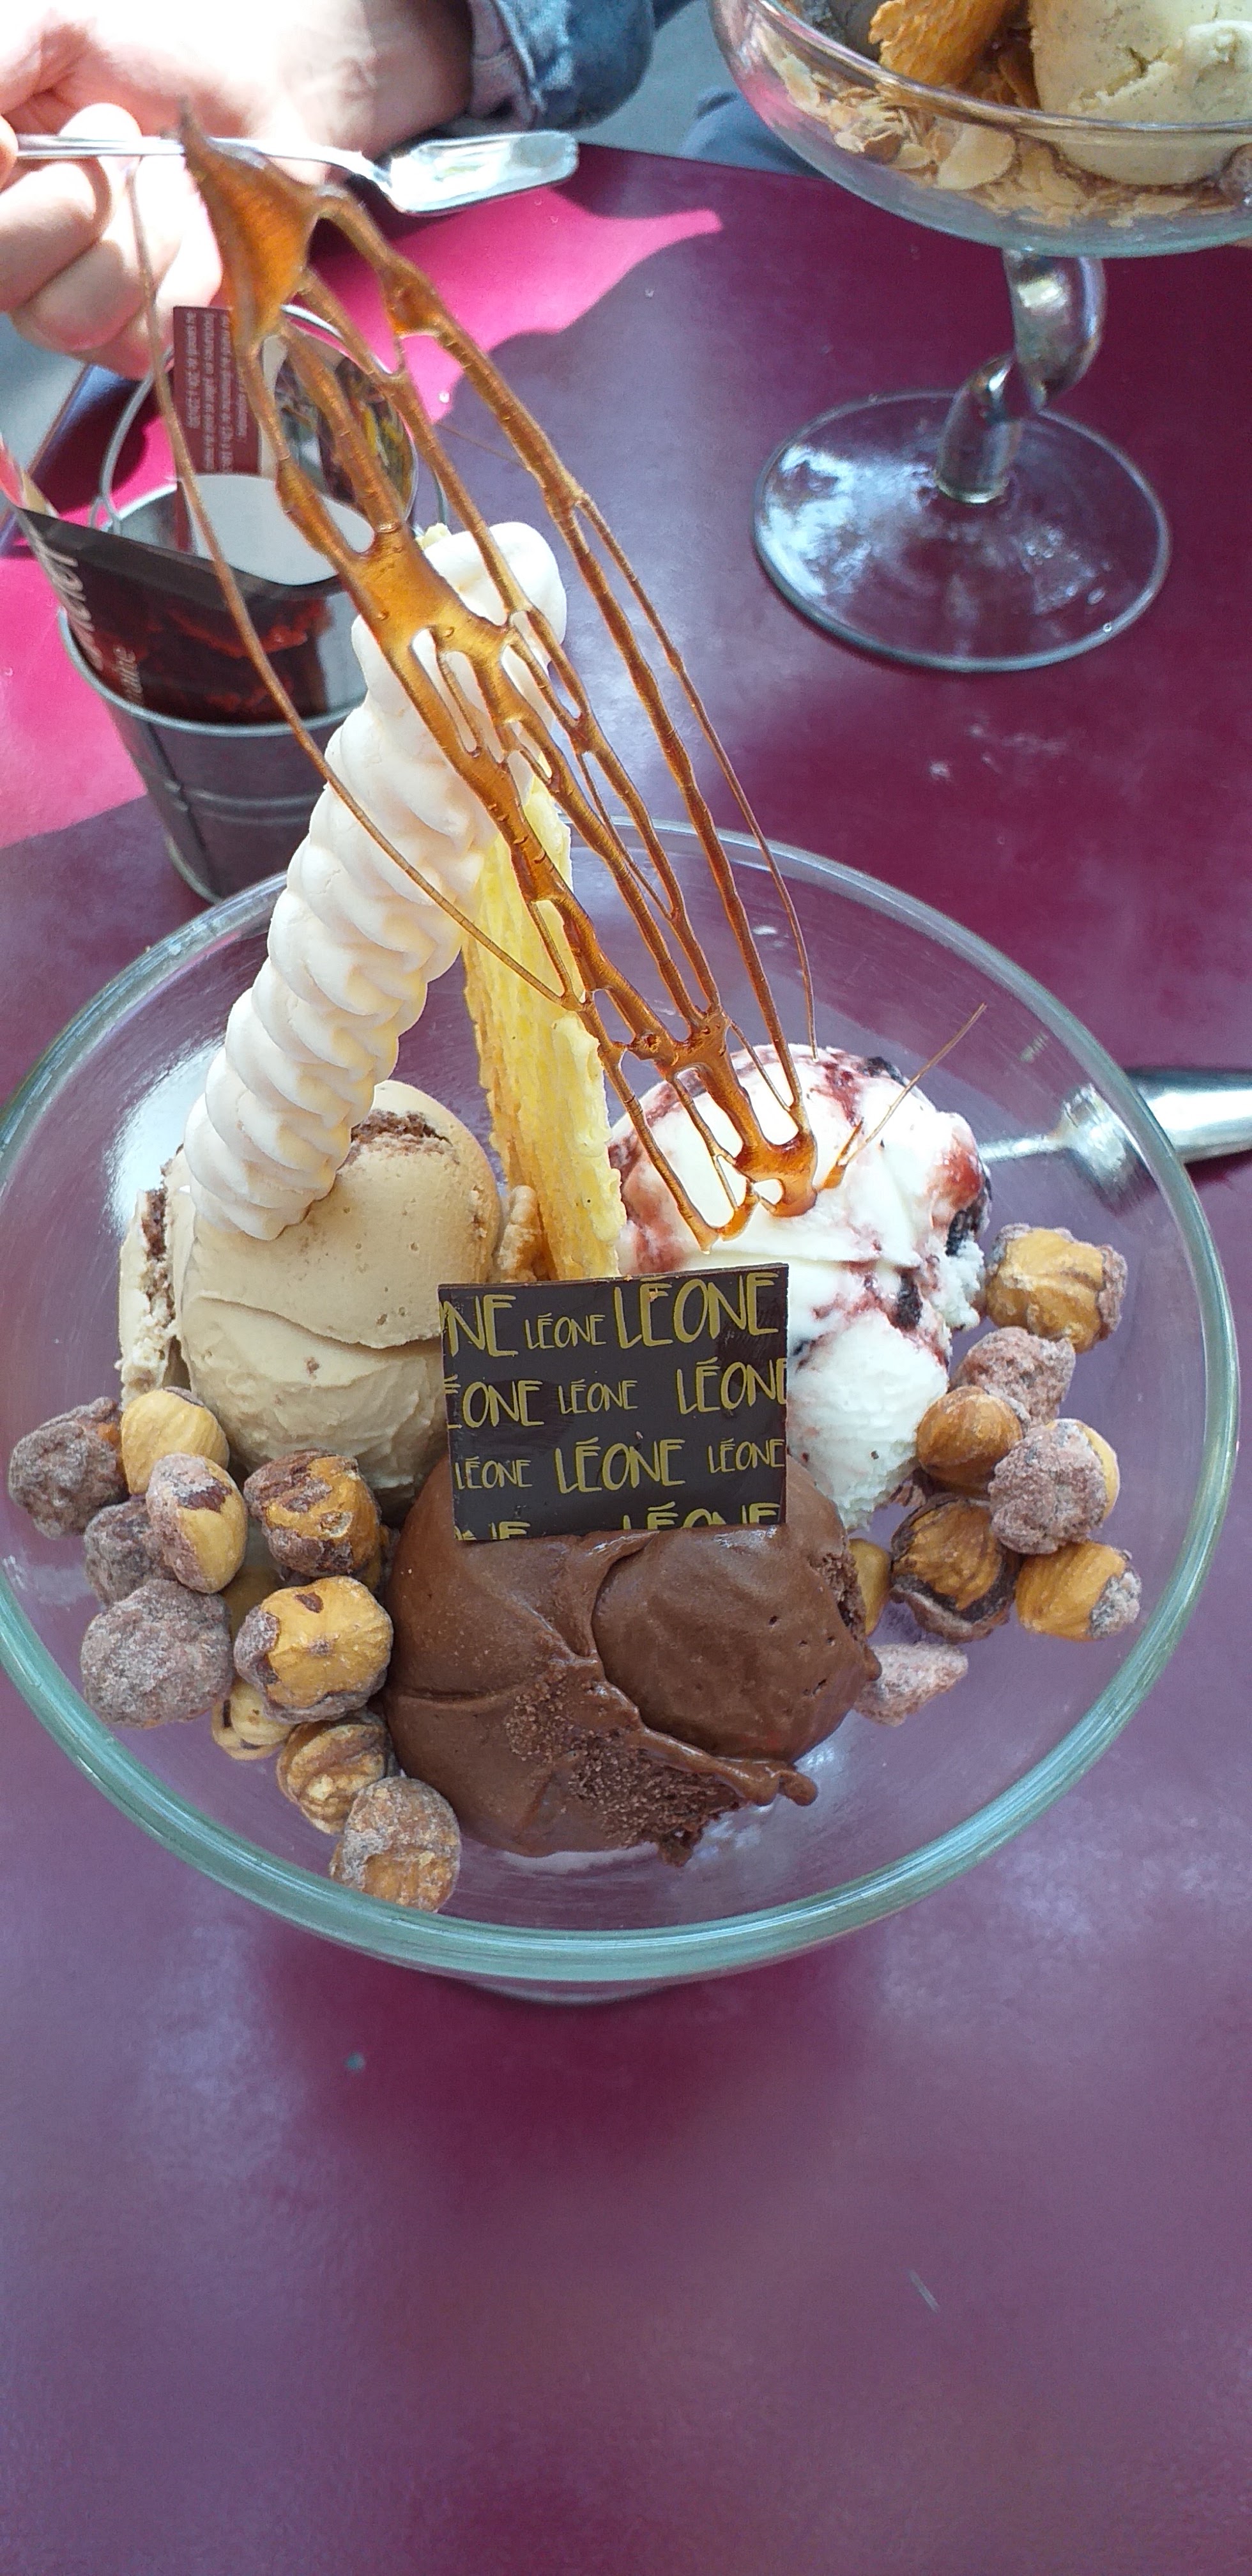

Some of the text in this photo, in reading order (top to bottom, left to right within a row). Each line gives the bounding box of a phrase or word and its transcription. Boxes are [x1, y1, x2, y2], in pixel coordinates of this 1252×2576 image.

[439, 1271, 779, 1358] NE LÉONE LÉONE
[557, 1379, 638, 1414] LÉONE
[455, 1437, 785, 1494] LÉONE LÉONE LÉONE
